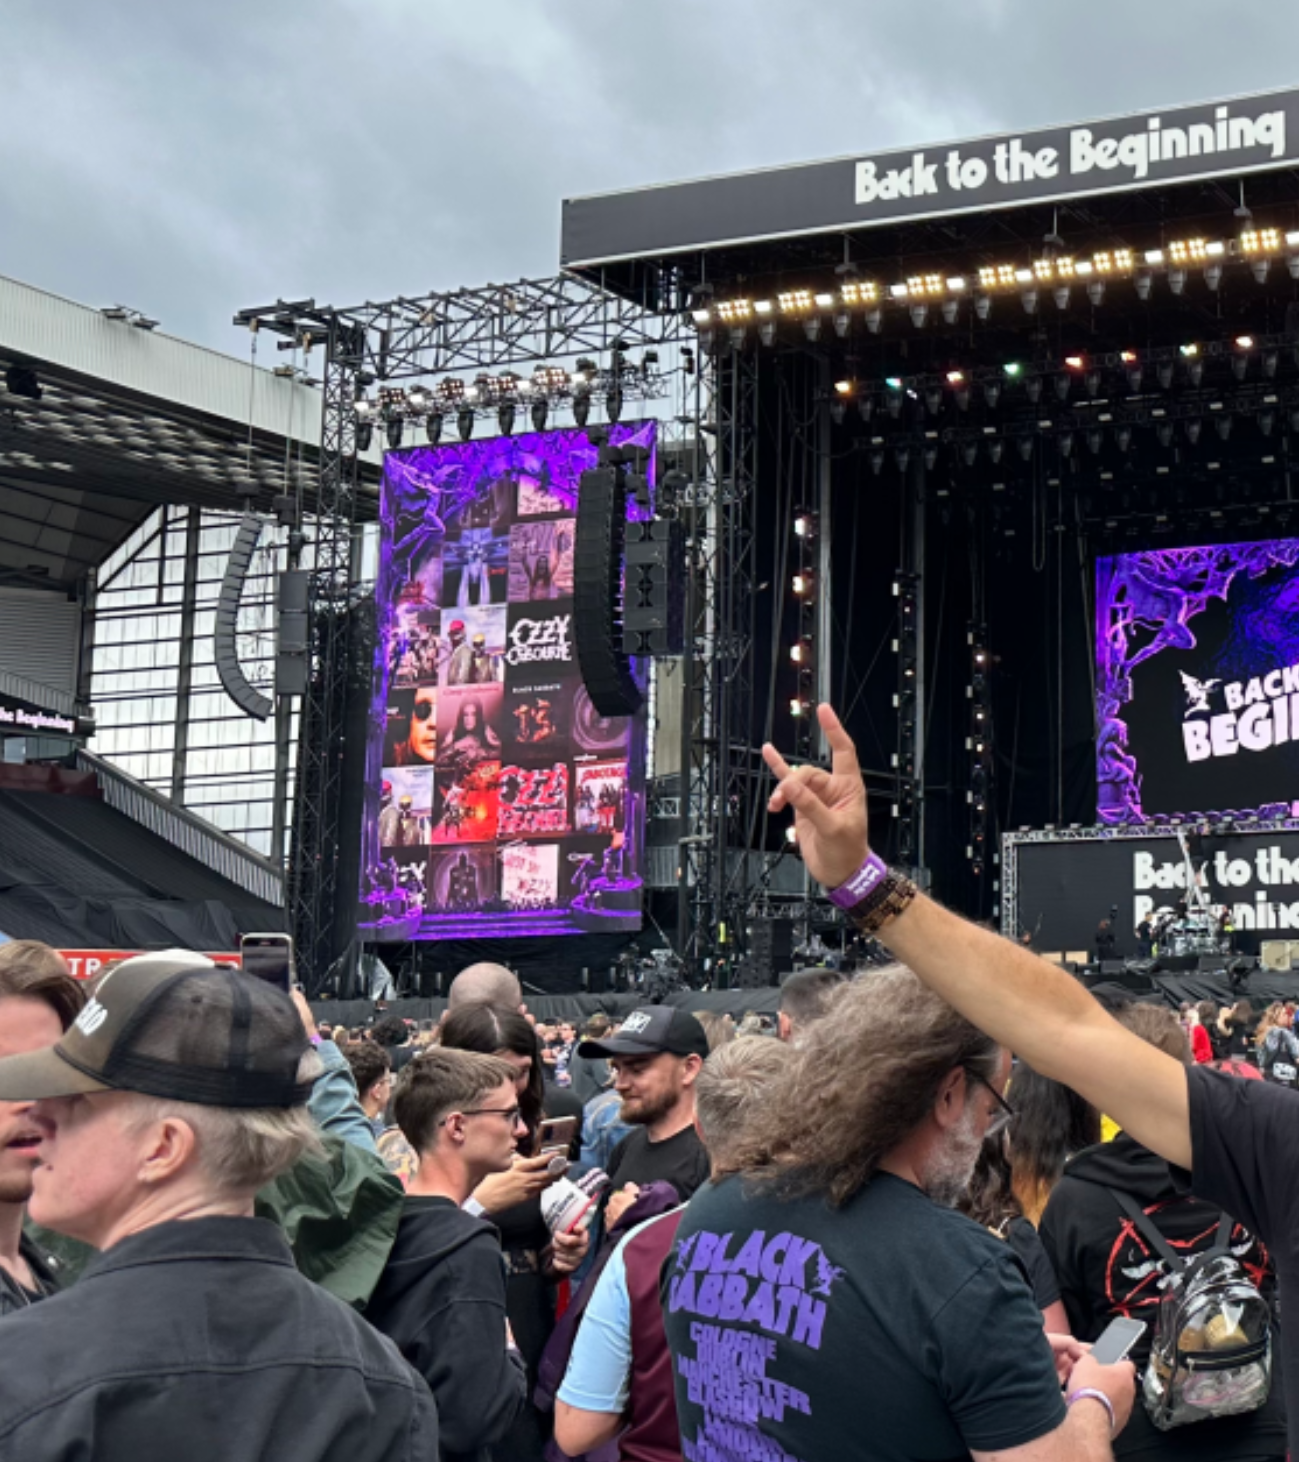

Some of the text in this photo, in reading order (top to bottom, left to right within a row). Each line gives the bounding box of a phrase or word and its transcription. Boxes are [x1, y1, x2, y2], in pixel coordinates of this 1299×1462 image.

[855, 106, 1286, 204] Back to the Beginning
[509, 614, 571, 646] OZZY
[1214, 850, 1252, 887] to
[689, 1230, 821, 1289] BLACK
